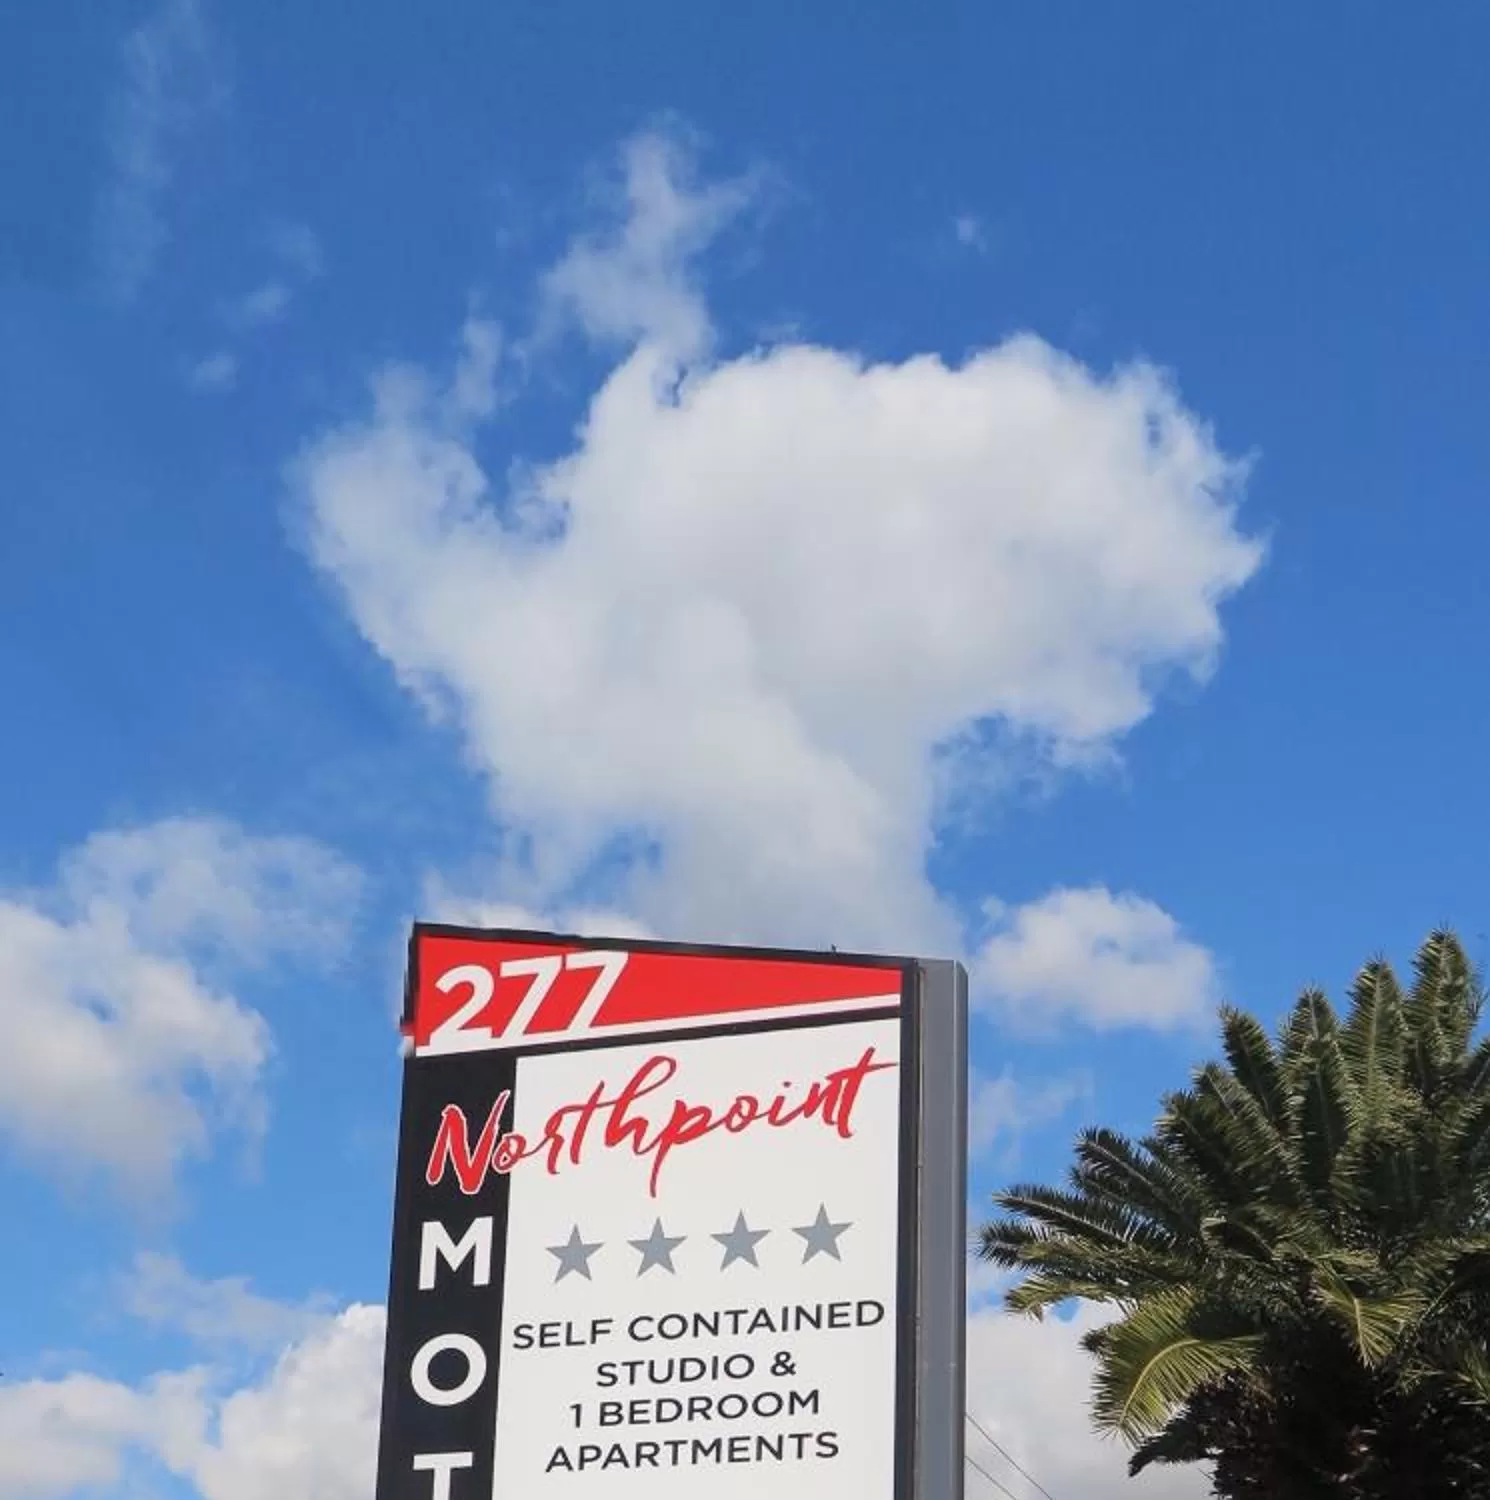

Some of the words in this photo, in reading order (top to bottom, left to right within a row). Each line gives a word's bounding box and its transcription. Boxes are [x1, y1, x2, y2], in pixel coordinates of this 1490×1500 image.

[430, 950, 629, 1042] 277
[425, 1047, 899, 1198] Northpoint
[511, 1318, 614, 1351] SELF
[626, 1299, 886, 1342] CONTAINED
[596, 1354, 756, 1388] STUDIO
[769, 1350, 798, 1378] &
[569, 1403, 583, 1428] 1
[598, 1389, 820, 1427] BEDROOM
[545, 1432, 840, 1474] APARTMENTS
